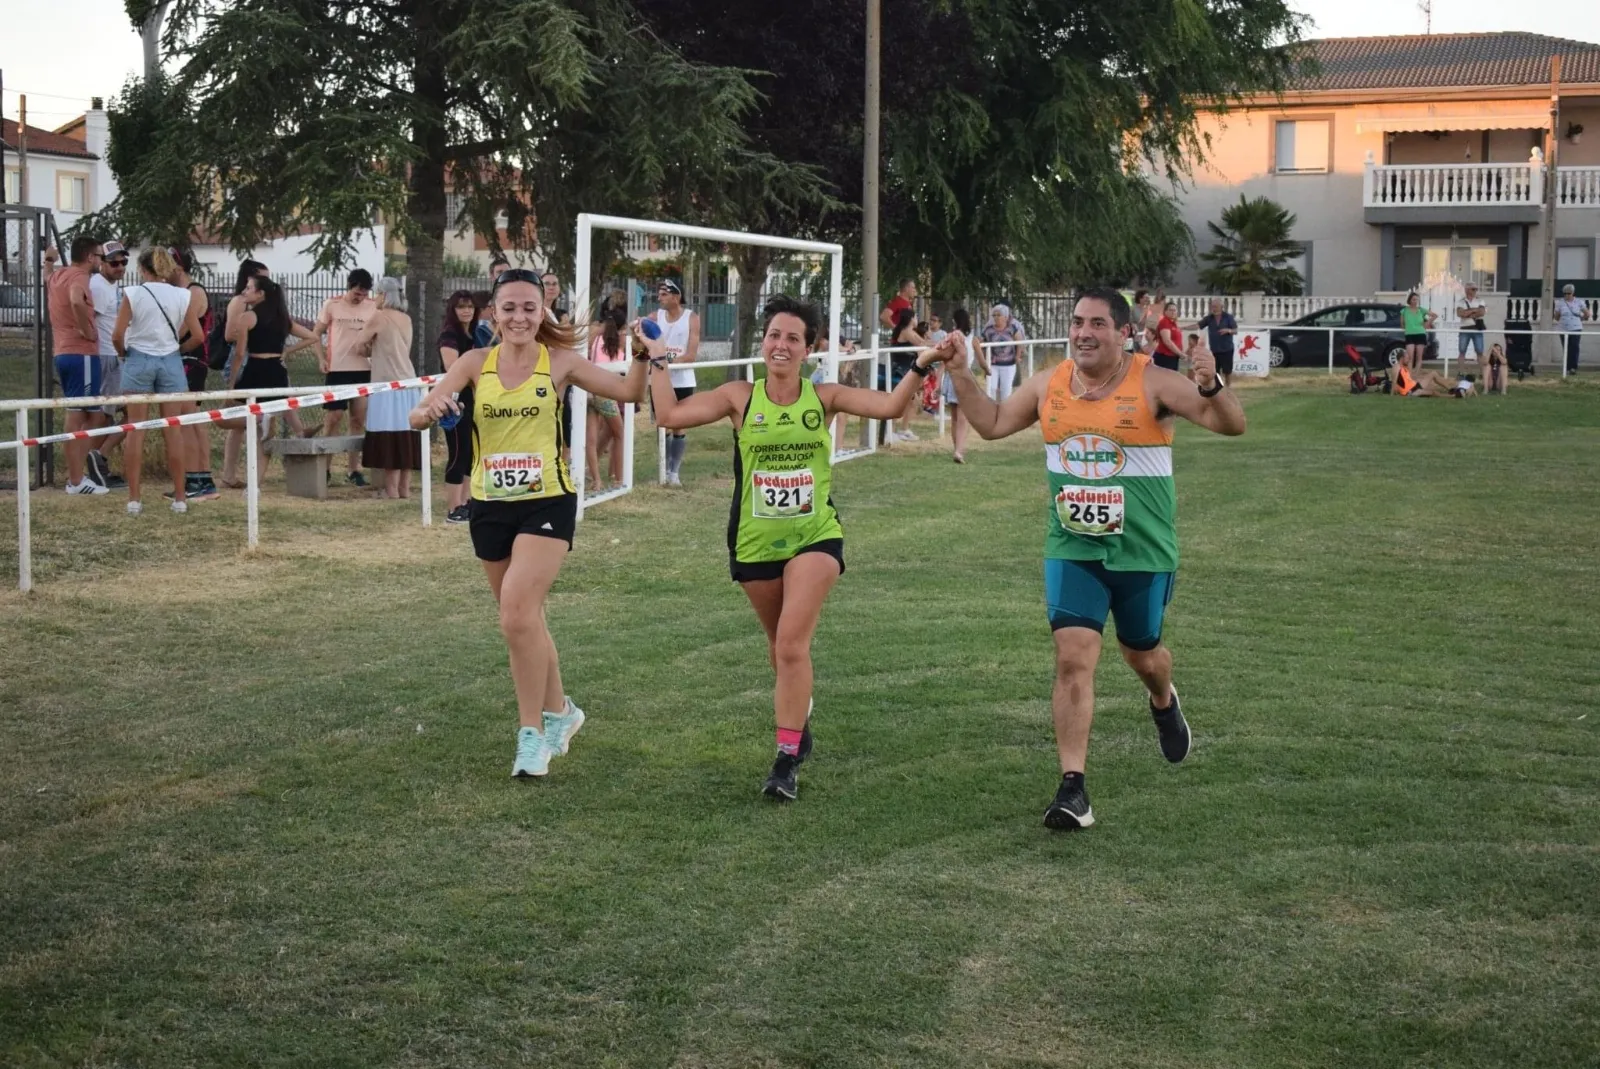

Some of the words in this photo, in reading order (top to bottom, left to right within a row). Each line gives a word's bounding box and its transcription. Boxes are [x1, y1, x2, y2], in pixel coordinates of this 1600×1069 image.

[1235, 364, 1258, 372] LESA
[750, 440, 824, 453] CORRECAMINOS
[758, 451, 815, 463] CARBAJOSA
[1066, 450, 1119, 465] ALCER
[766, 463, 807, 471] SALAMANCA
[493, 469, 530, 488] 352
[754, 473, 813, 489] bedunia
[765, 487, 801, 508] 321
[1069, 503, 1110, 524] 265
